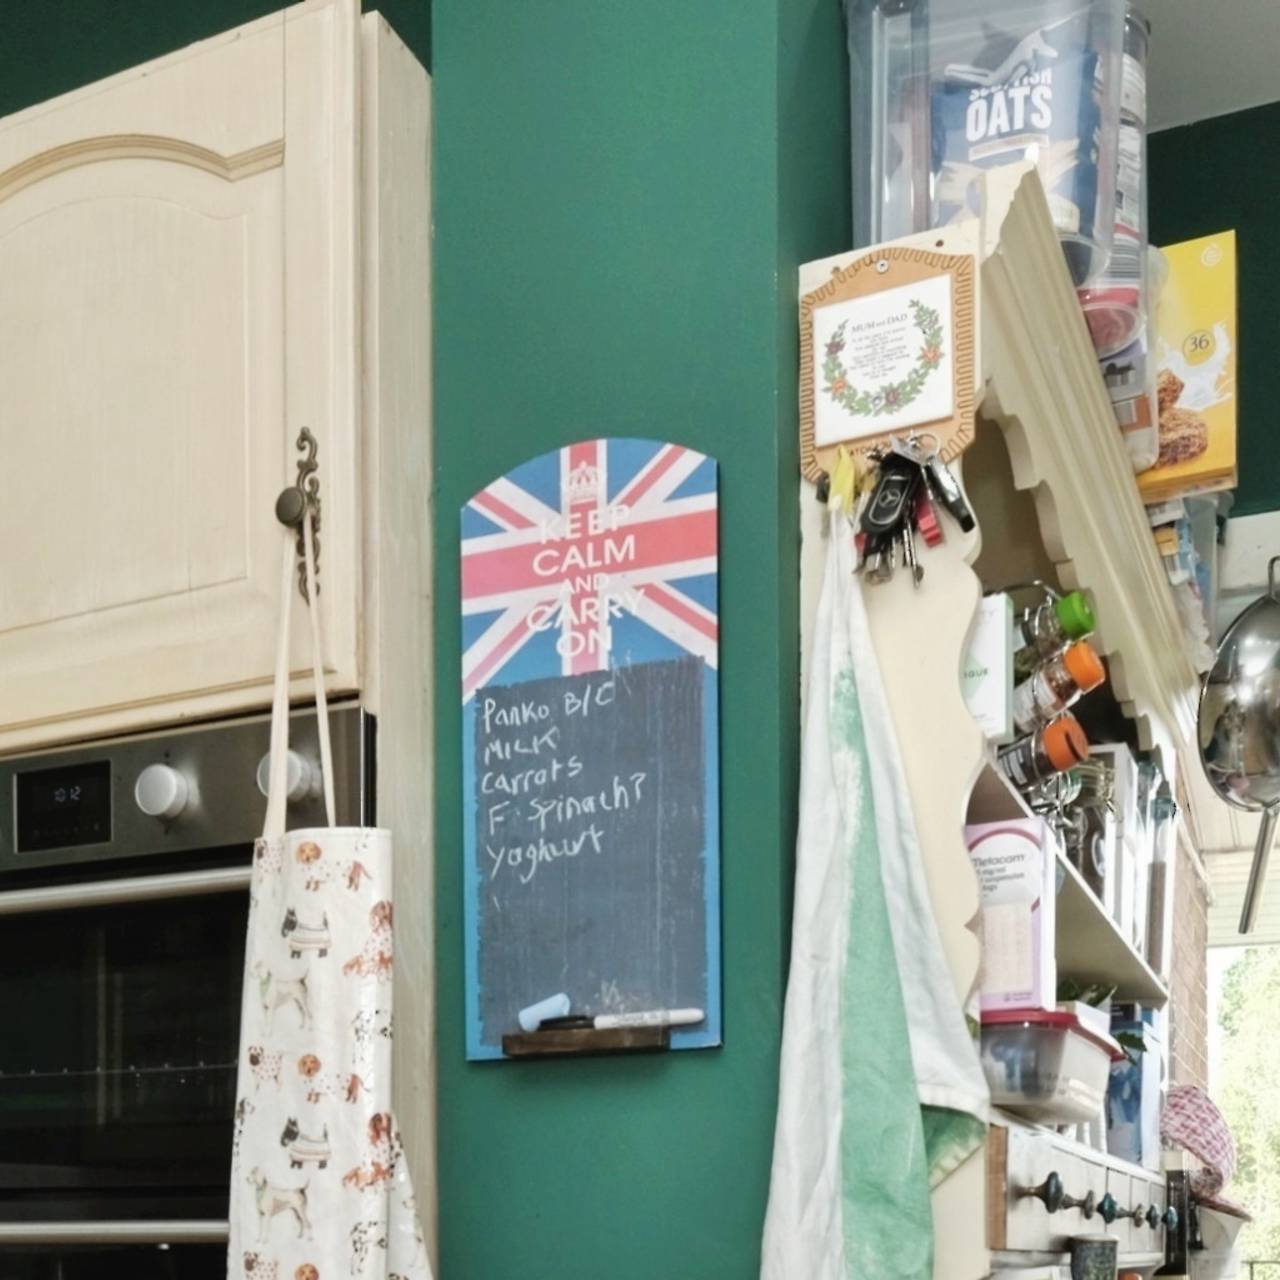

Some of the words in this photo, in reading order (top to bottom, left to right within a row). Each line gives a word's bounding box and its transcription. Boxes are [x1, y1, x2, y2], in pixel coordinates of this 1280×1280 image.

[966, 86, 1052, 142] OATS
[1189, 334, 1210, 353] 36
[539, 503, 632, 545] KEEP
[532, 534, 636, 577] CALM
[560, 572, 610, 596] AND
[526, 587, 647, 632] CARRY
[556, 625, 613, 659] ON
